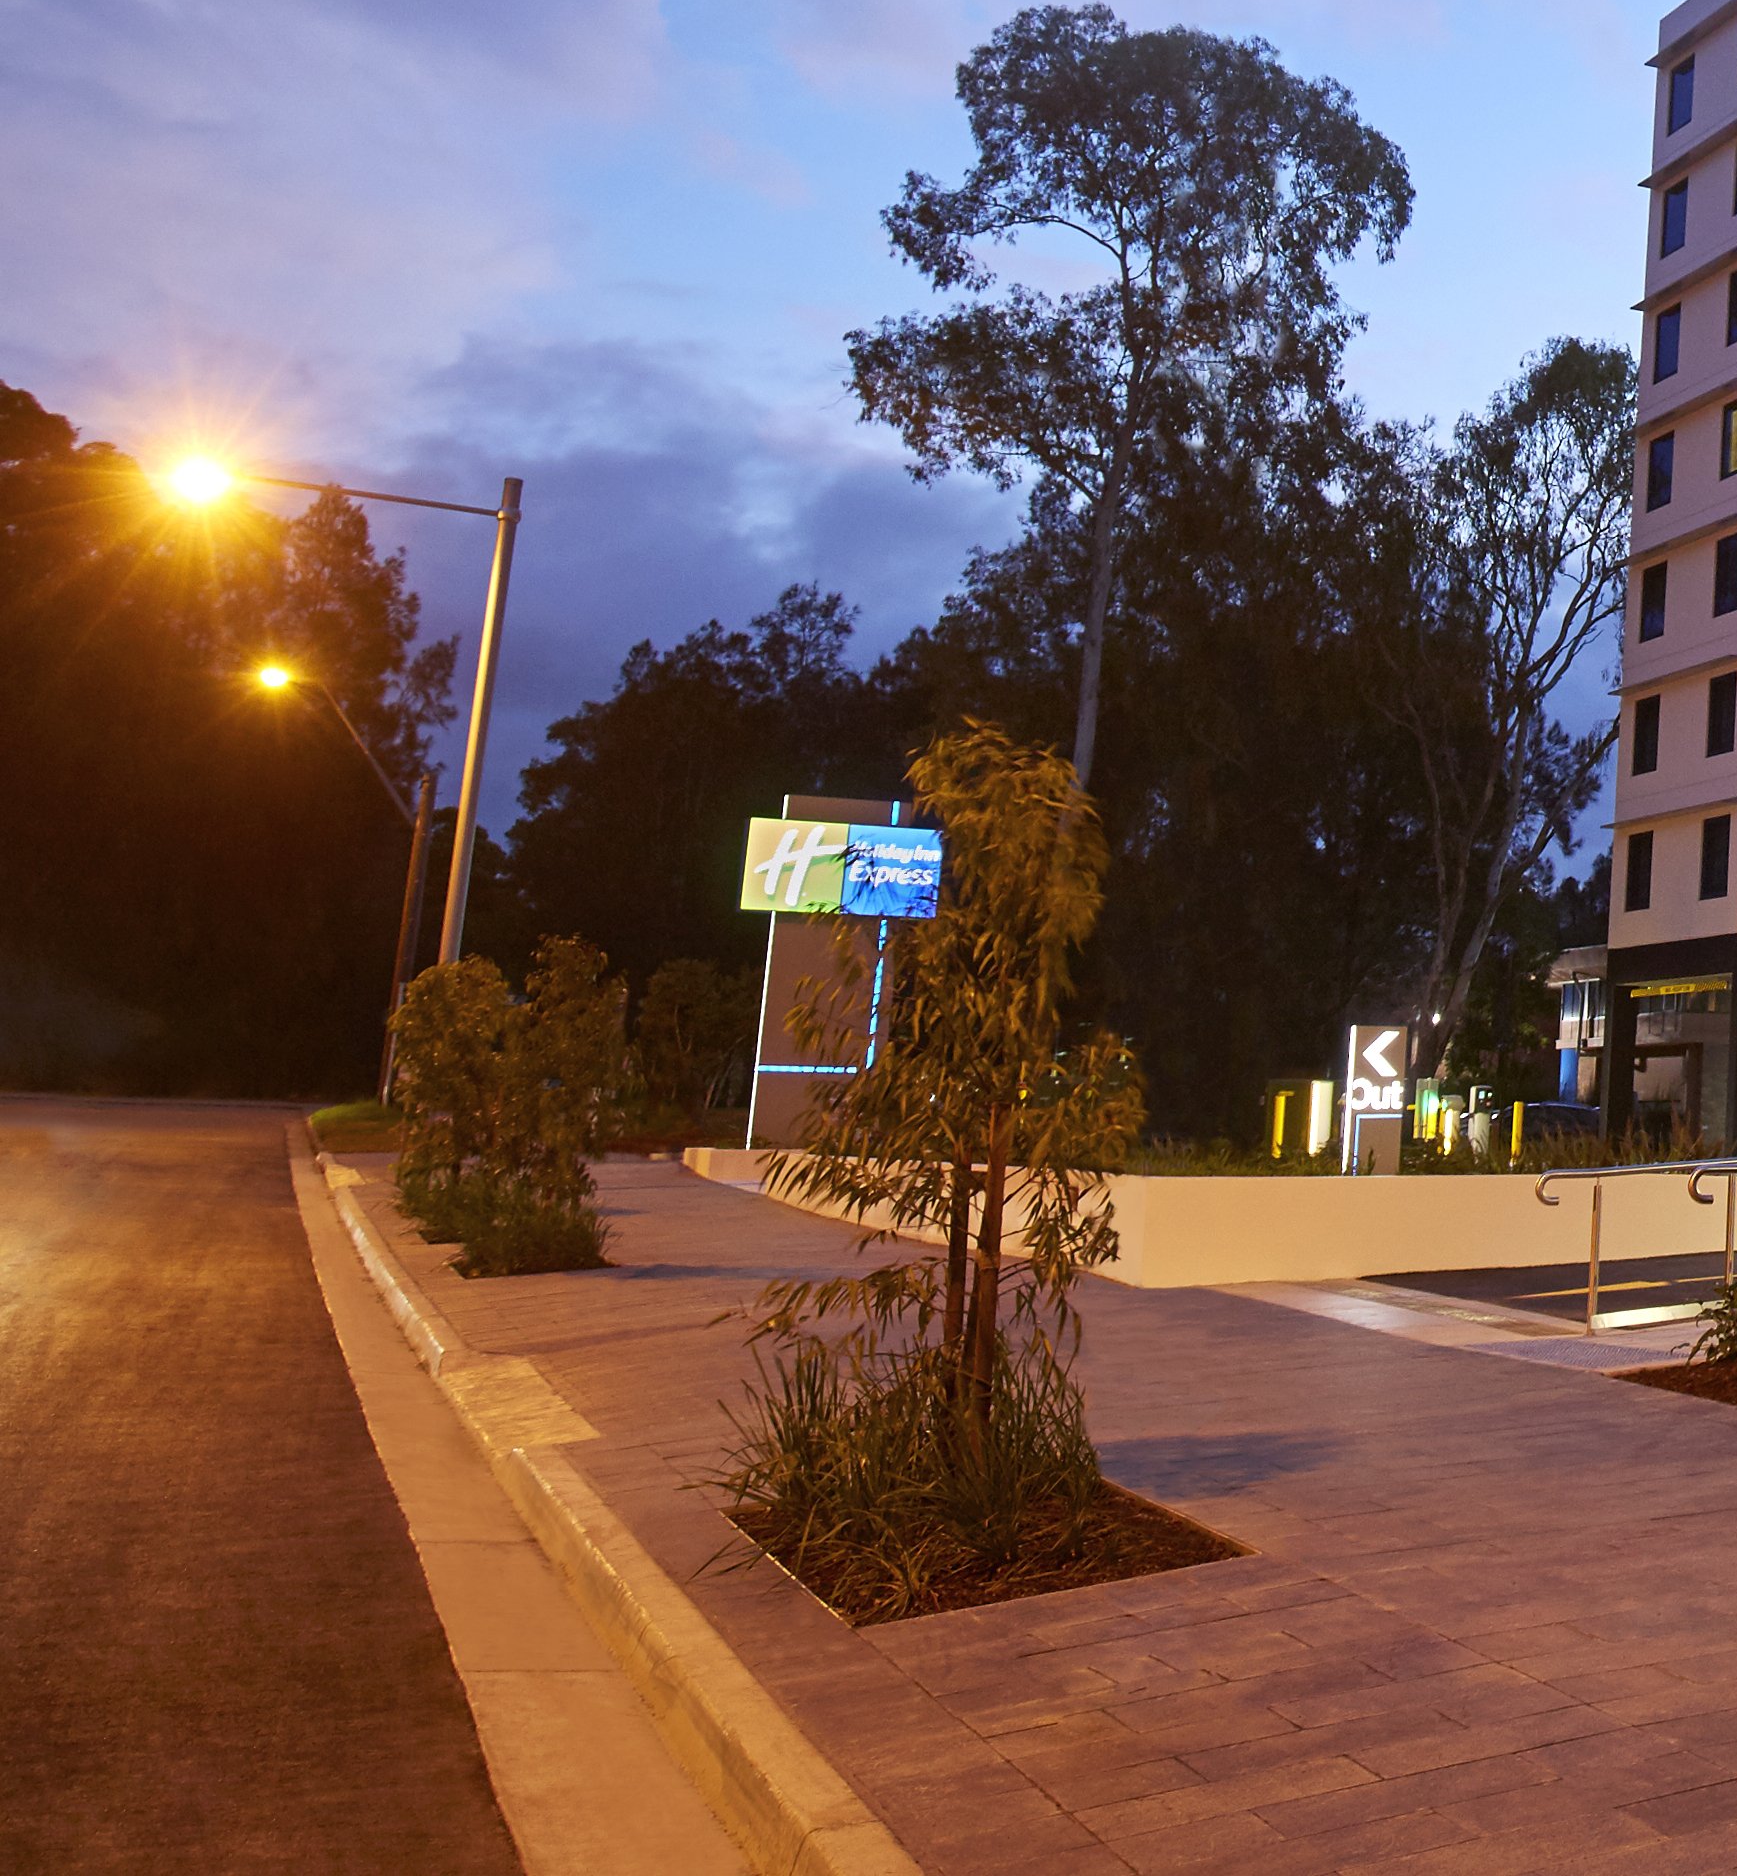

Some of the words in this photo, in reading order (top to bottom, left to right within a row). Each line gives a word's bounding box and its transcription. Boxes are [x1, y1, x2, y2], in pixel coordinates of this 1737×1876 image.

[913, 844, 942, 862] Inn
[848, 859, 935, 888] Express
[1351, 1077, 1404, 1111] Out
